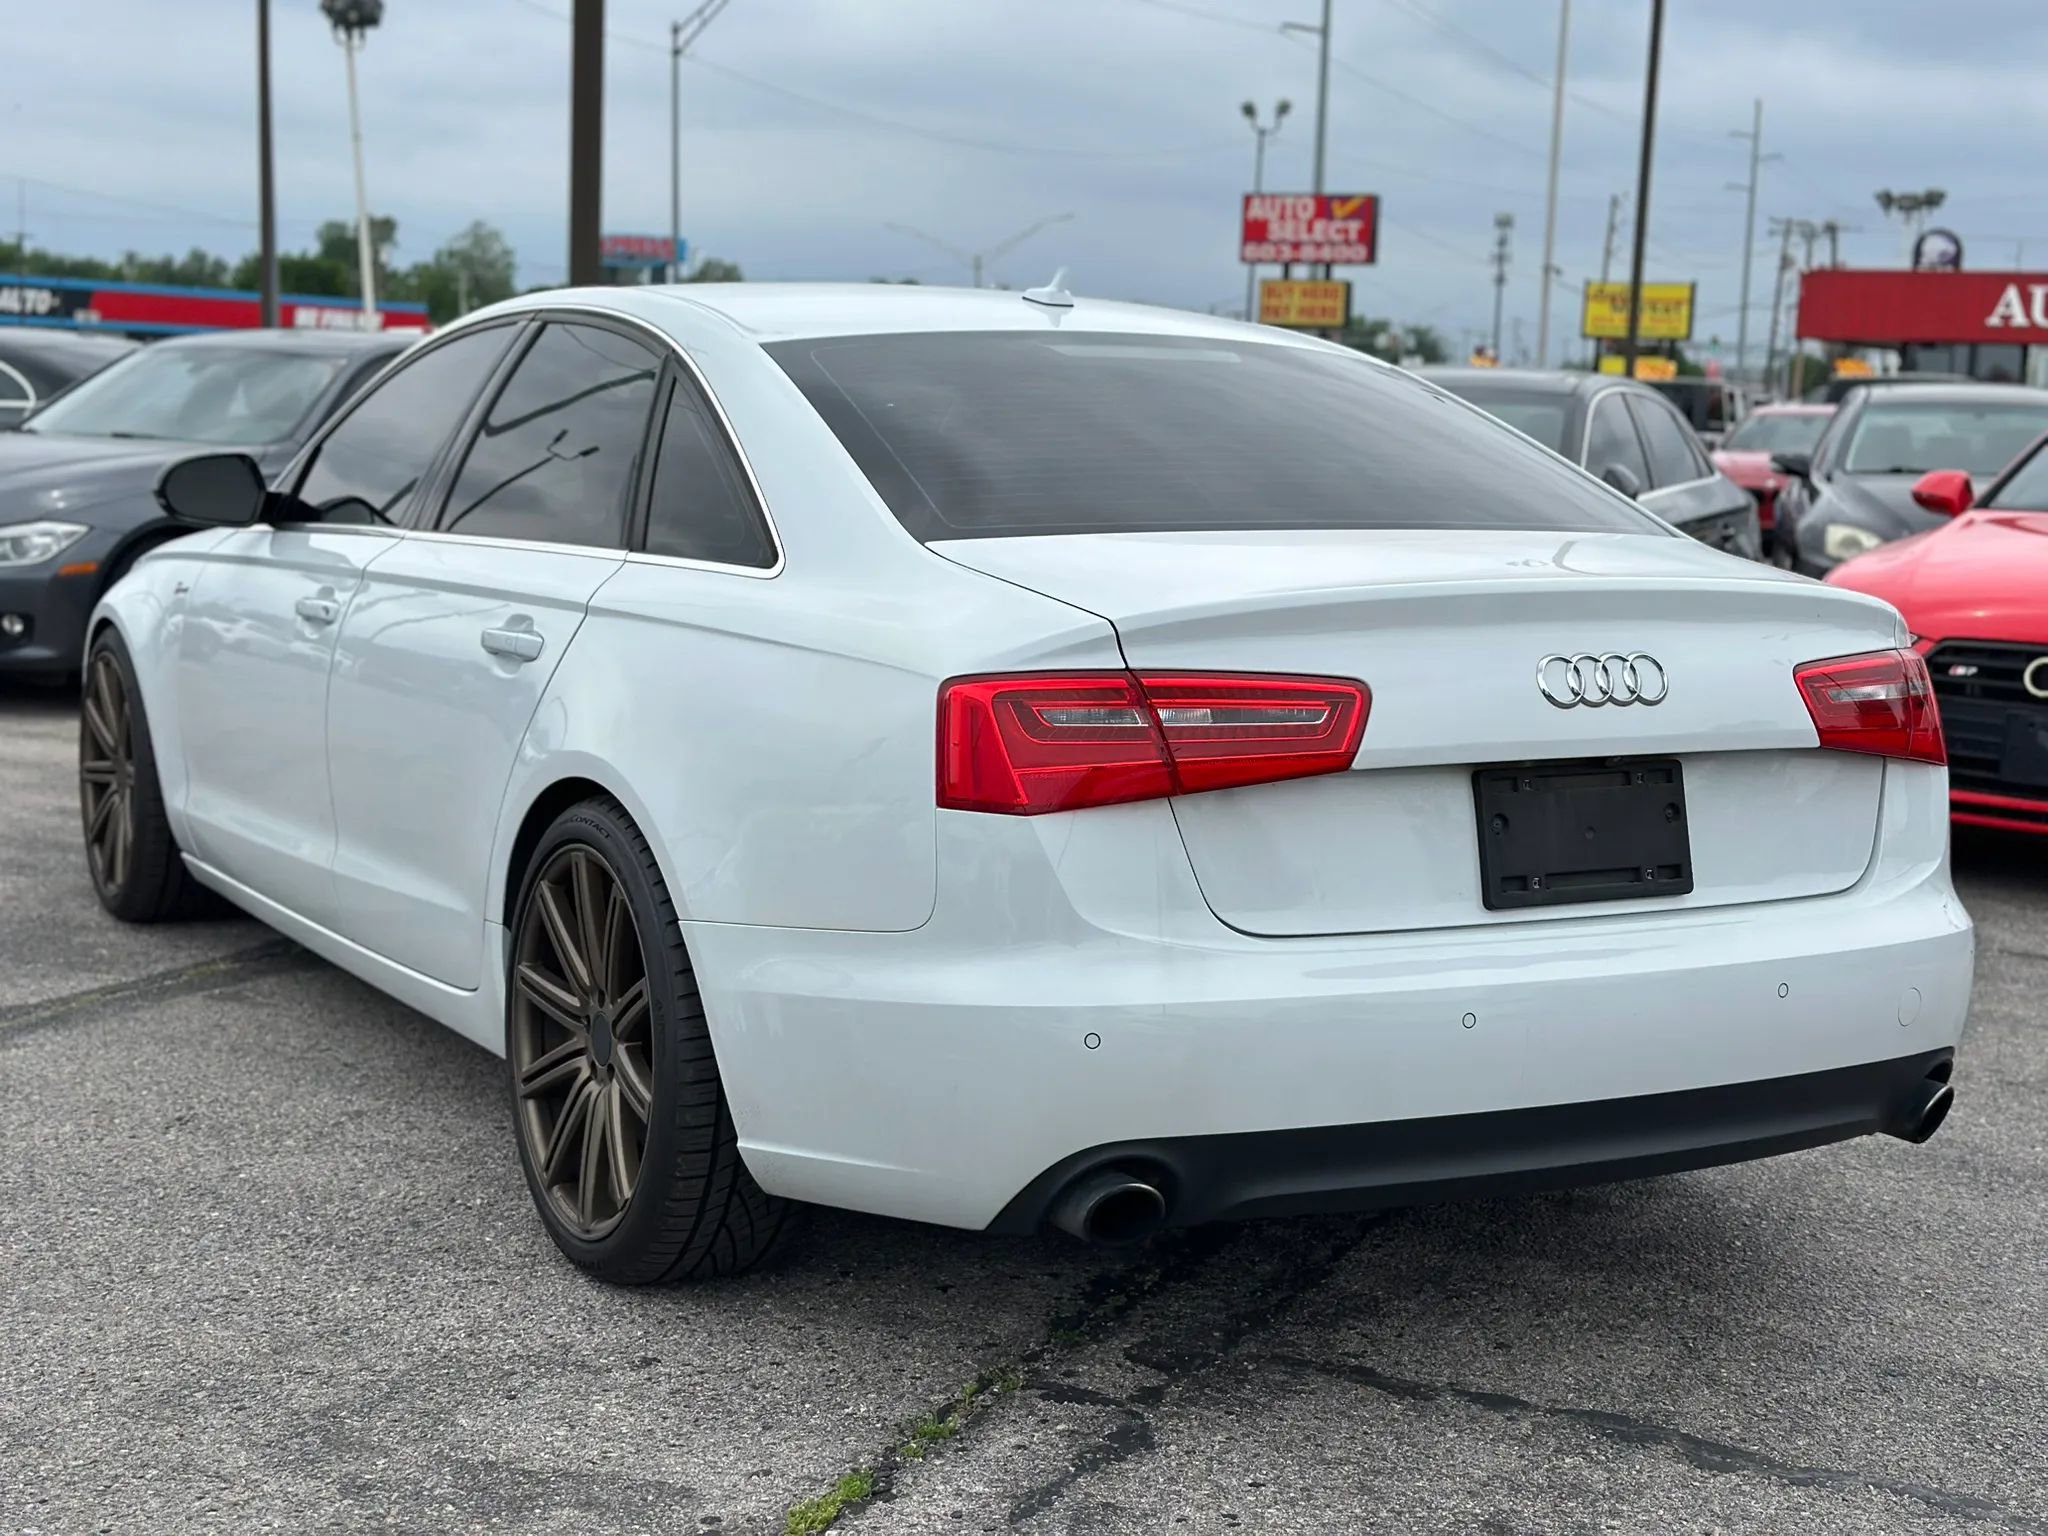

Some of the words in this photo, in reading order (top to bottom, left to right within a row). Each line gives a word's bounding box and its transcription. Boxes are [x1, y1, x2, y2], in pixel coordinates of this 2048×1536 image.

[1247, 197, 1316, 219] AUTO
[1266, 219, 1362, 241] SELECT
[571, 815, 611, 839] CONTACT
